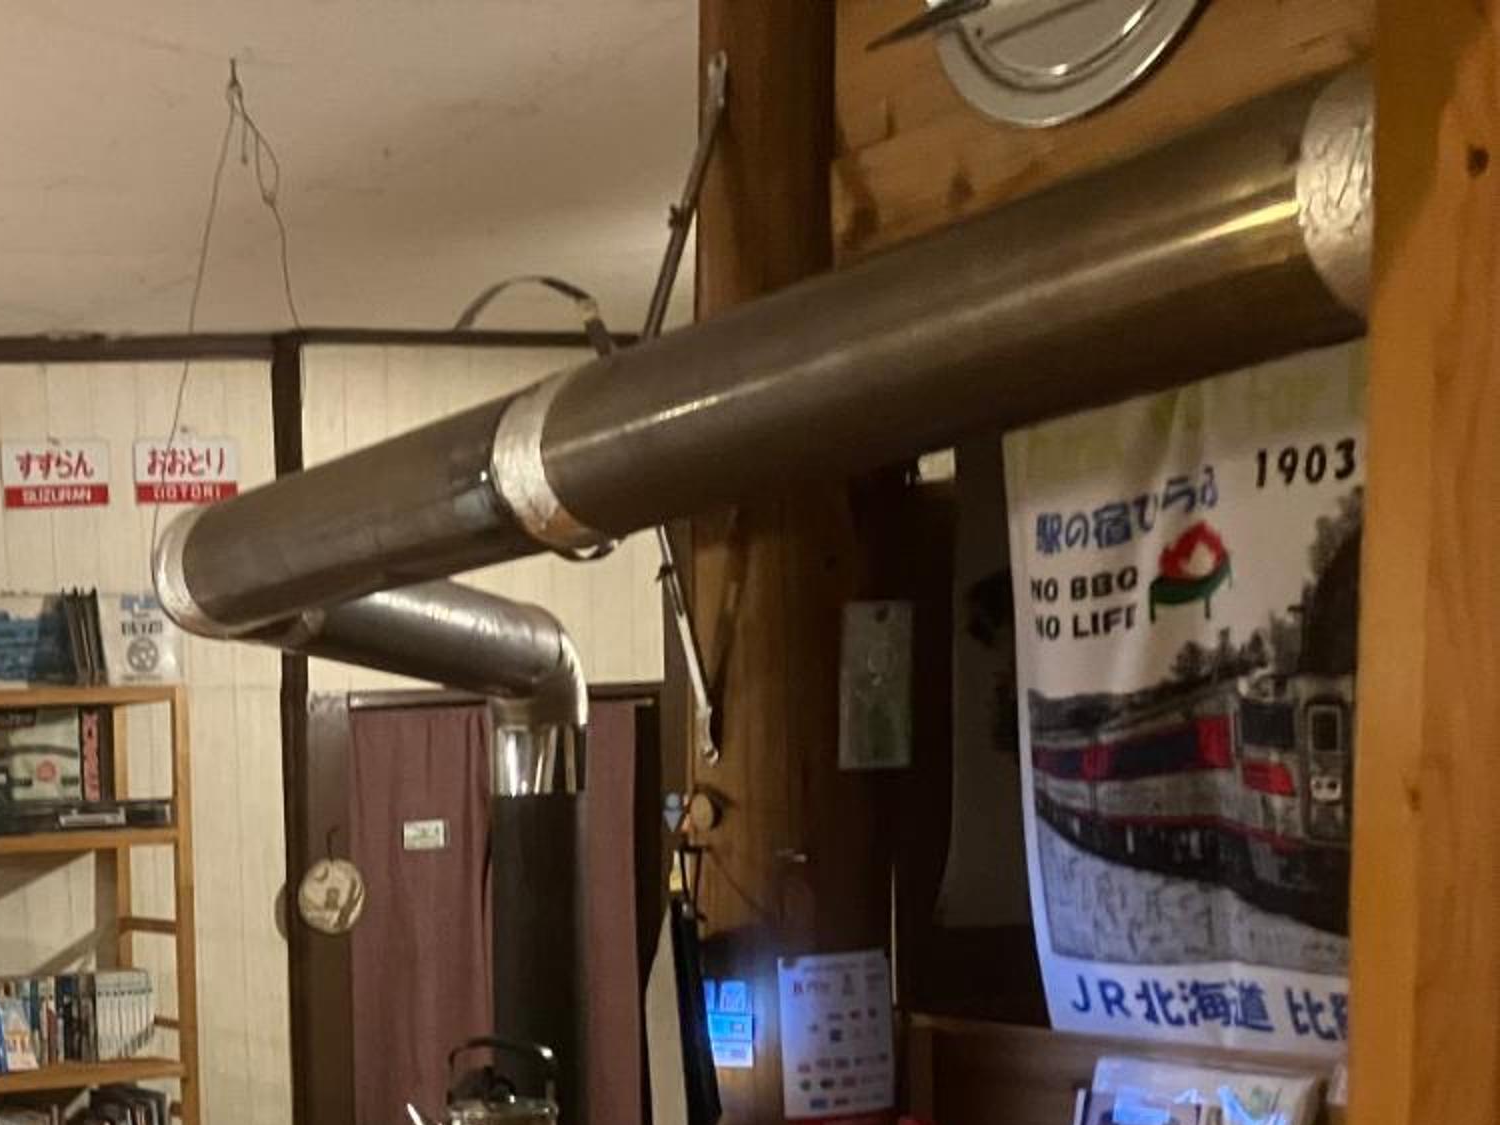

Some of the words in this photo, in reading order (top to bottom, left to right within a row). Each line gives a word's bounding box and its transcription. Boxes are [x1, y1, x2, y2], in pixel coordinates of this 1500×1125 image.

[16, 449, 94, 480] すずらん
[147, 447, 224, 477] おおとり
[1255, 438, 1356, 488] 1903
[1072, 974, 1275, 1032] JR北海道
